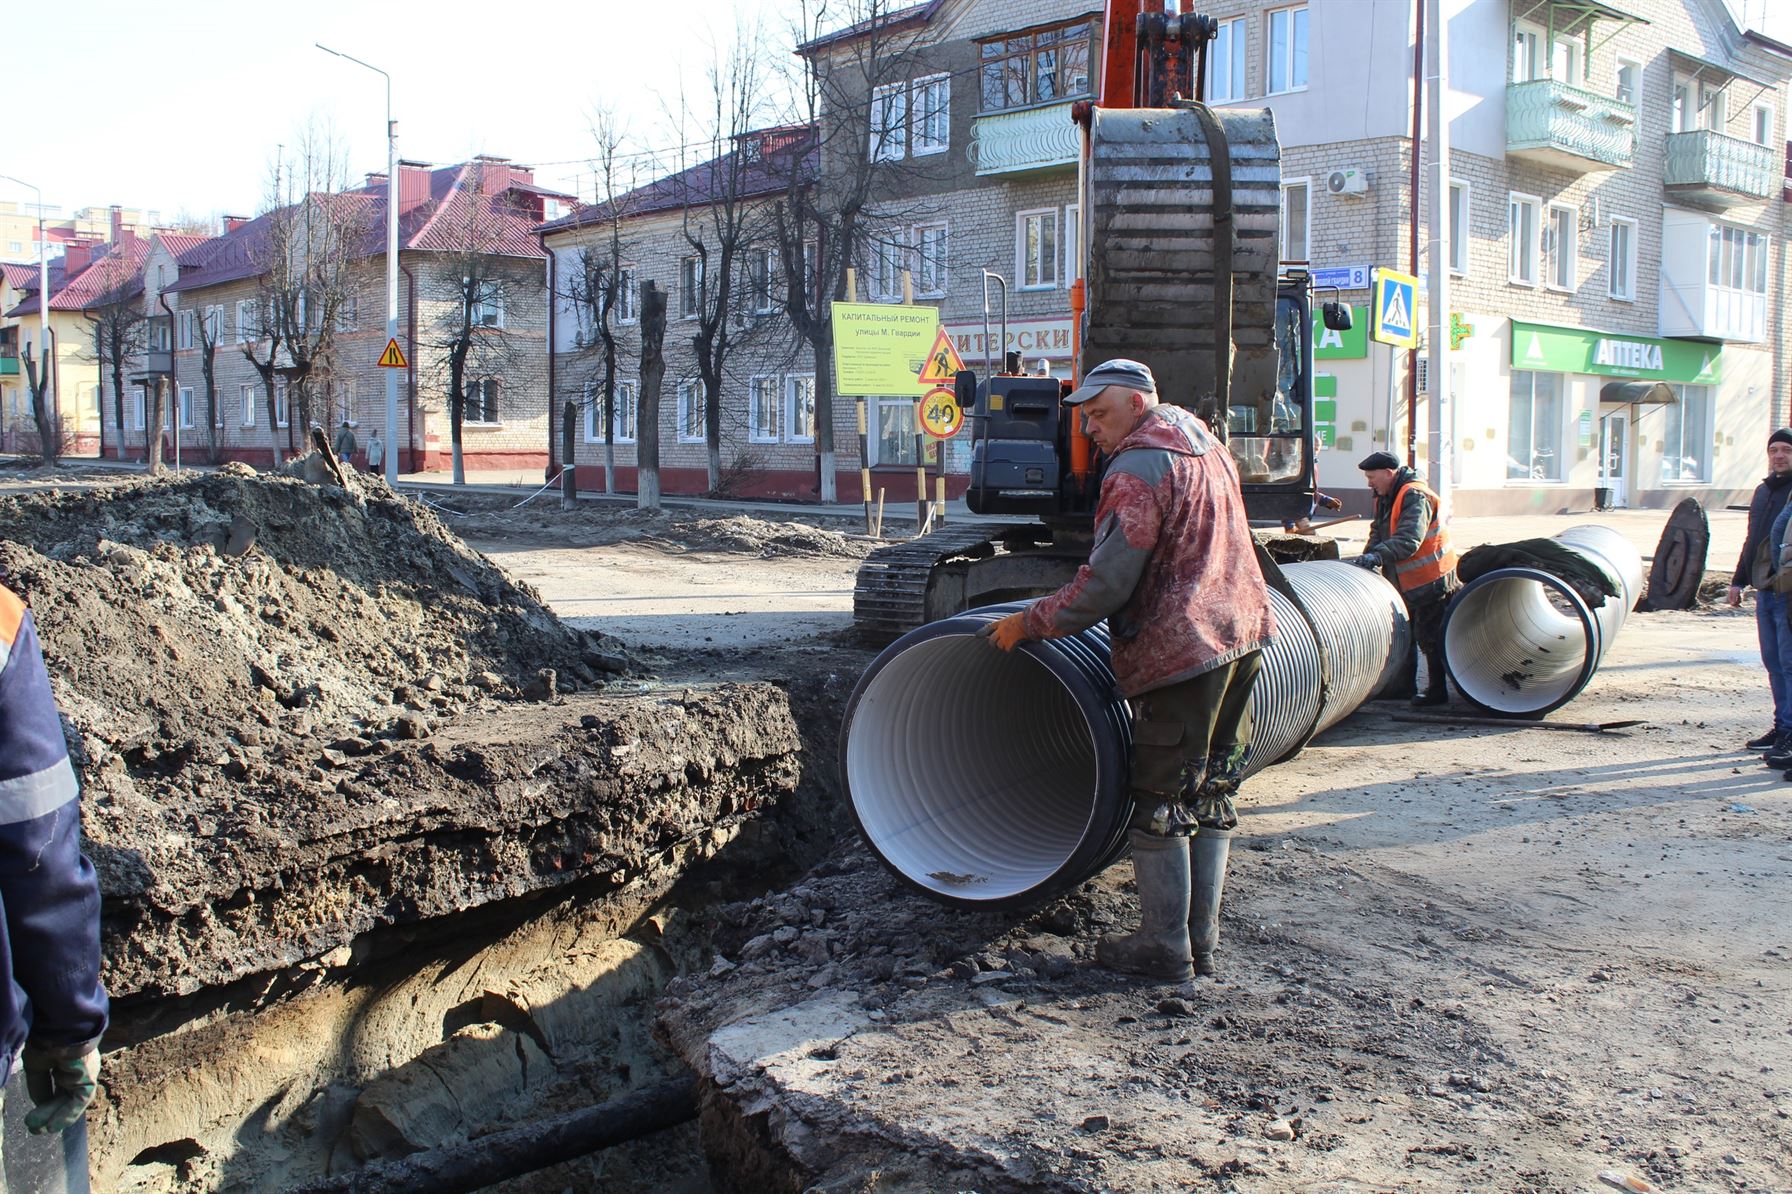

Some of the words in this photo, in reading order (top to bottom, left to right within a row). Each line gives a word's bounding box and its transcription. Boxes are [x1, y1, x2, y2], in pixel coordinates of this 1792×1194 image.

[1353, 270, 1363, 284] 8
[841, 312, 899, 323] КАПИТАЛЬНЫЙ
[900, 316, 930, 324] РЕМОНТ
[855, 328, 879, 337] улицы
[881, 328, 890, 336] М.
[891, 329, 921, 338] Гвардии
[949, 329, 1070, 353] ИТЕРСКИ
[1593, 338, 1664, 370] АПТЕКА
[927, 404, 955, 424] 40
